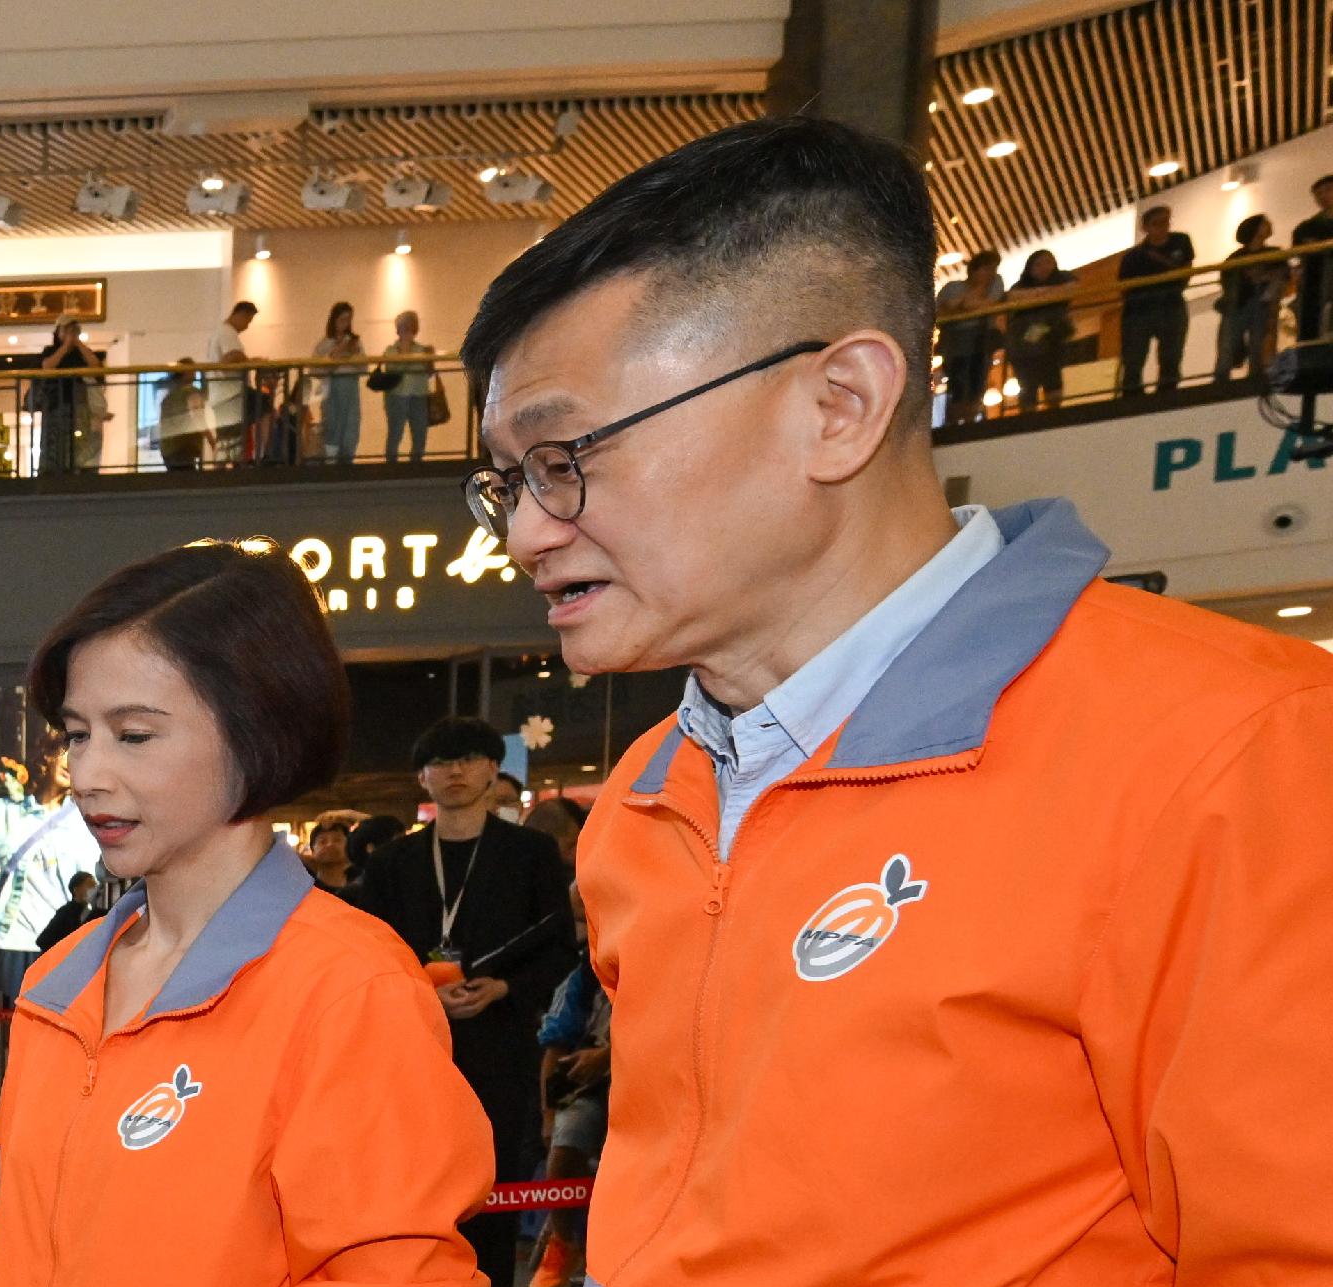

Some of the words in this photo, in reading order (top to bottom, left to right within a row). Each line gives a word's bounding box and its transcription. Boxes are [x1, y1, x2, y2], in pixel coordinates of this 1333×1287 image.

[183, 534, 438, 583] ORT
[802, 929, 874, 947] MPFA
[486, 1186, 587, 1206] OLLYWOOD
